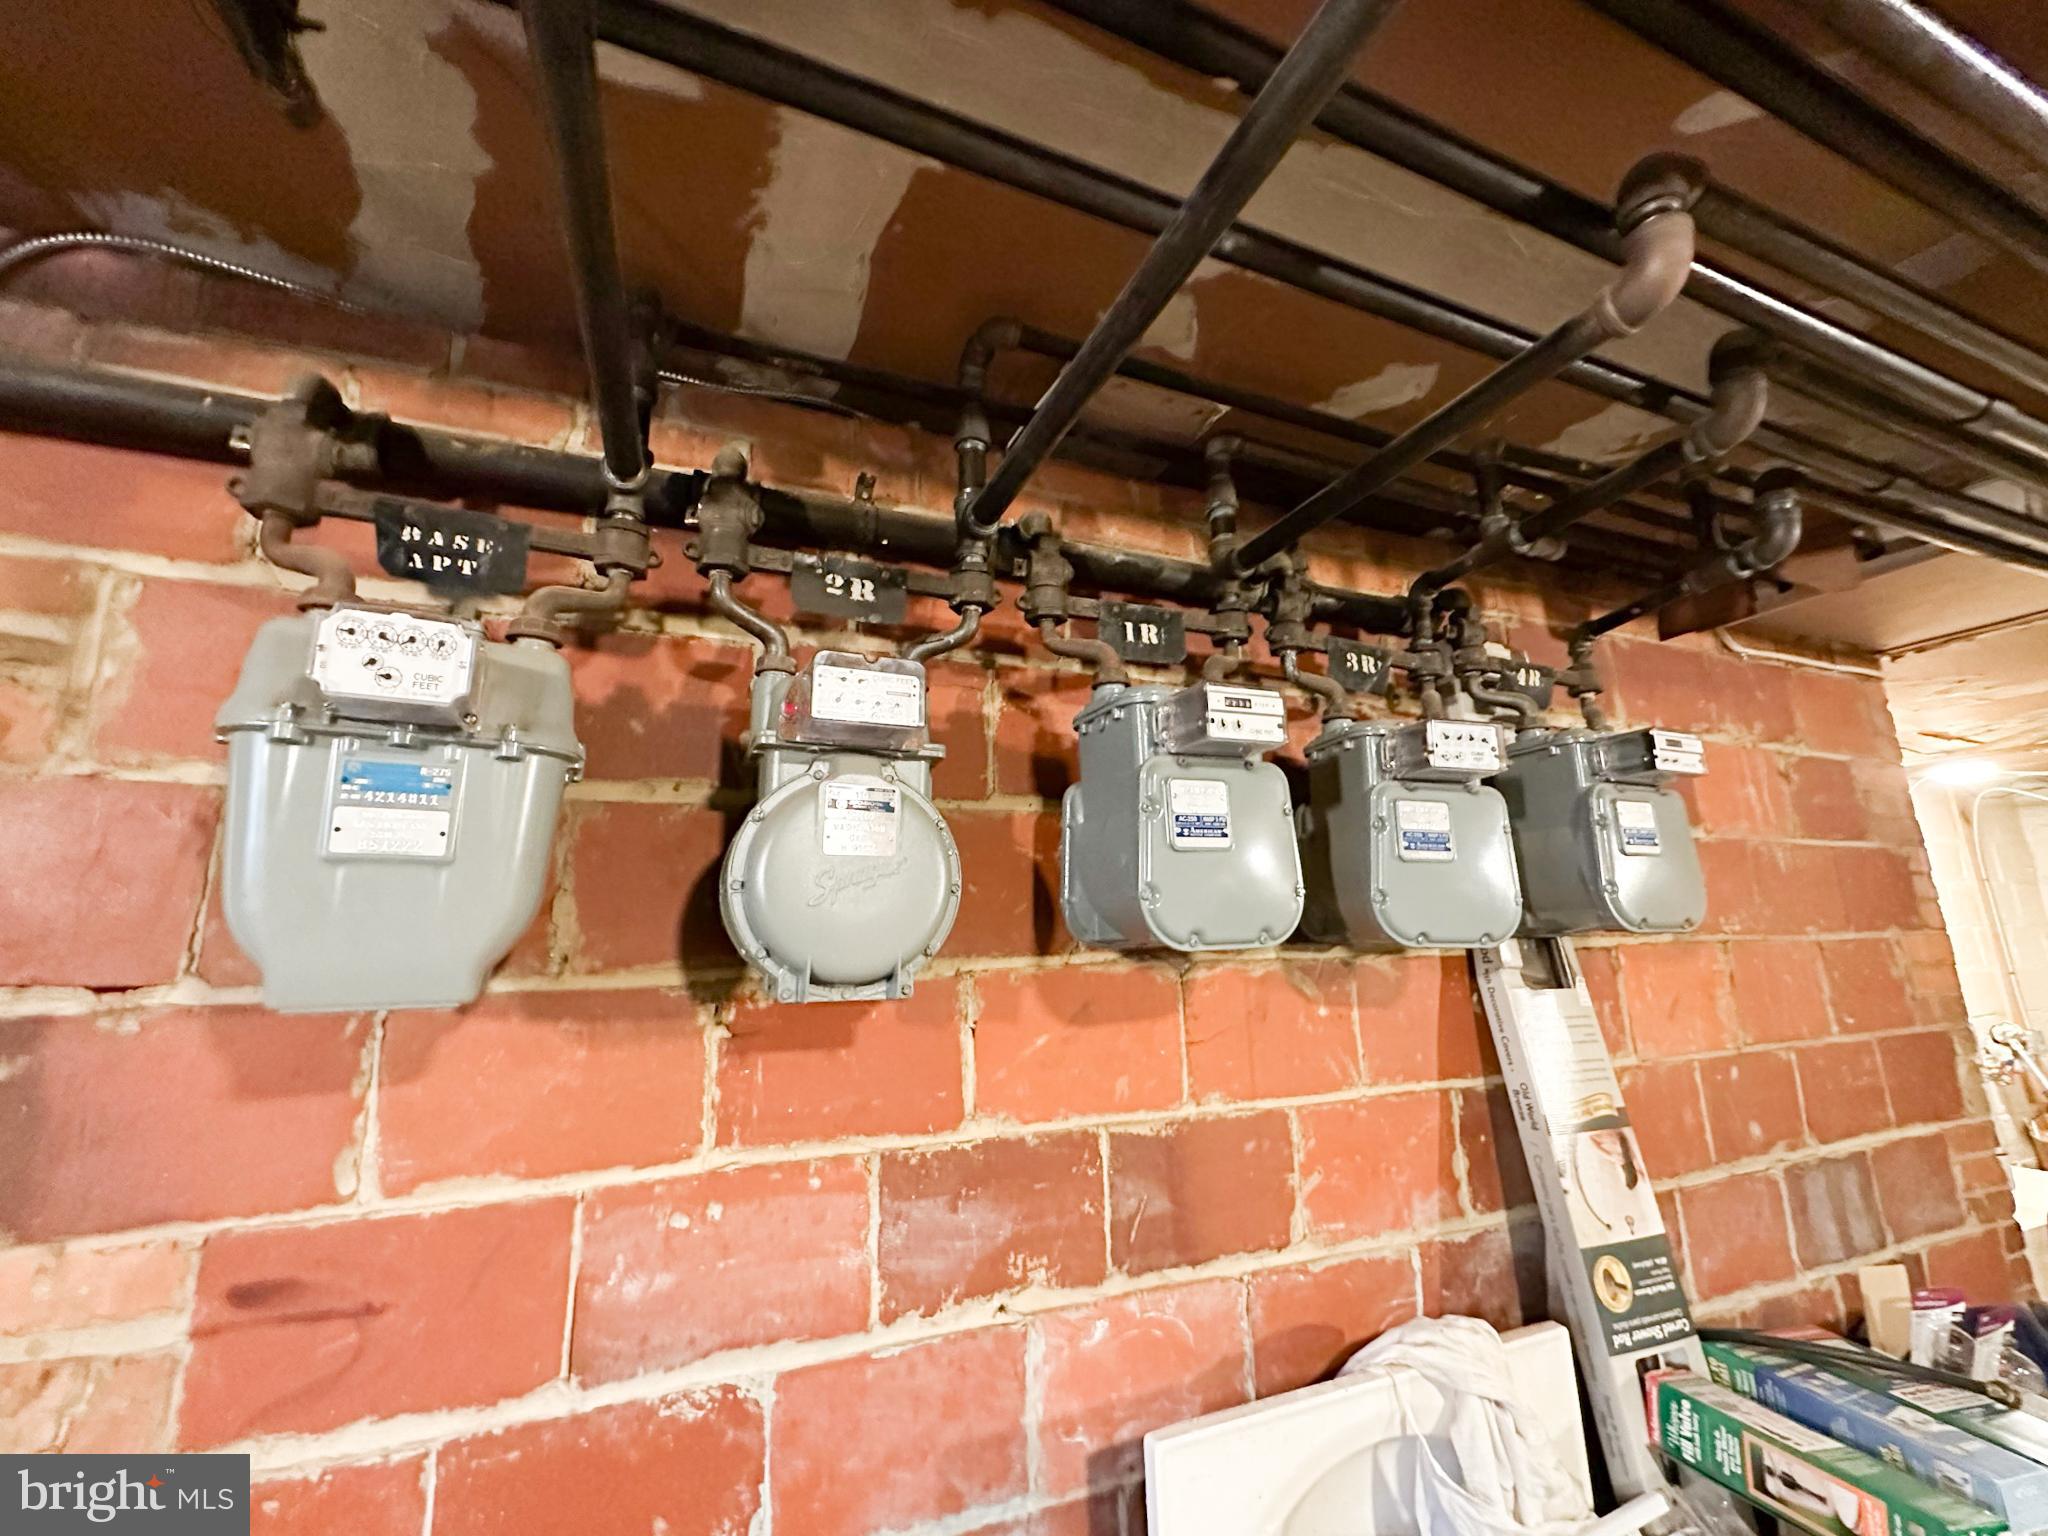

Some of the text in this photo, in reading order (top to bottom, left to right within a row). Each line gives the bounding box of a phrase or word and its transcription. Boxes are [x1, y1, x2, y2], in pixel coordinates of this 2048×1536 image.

[408, 552, 478, 576] APT
[824, 573, 876, 602] 2R
[1124, 621, 1159, 645] 1R
[1346, 652, 1377, 674] 3R
[412, 682, 439, 691] FEET
[413, 672, 444, 684] CUBIC
[1488, 986, 1505, 1033] Decorative
[1501, 1036, 1513, 1065] Covers
[1519, 1082, 1540, 1131] Old World
[1612, 1332, 1632, 1350] Rod
[1631, 1324, 1663, 1342] Shower
